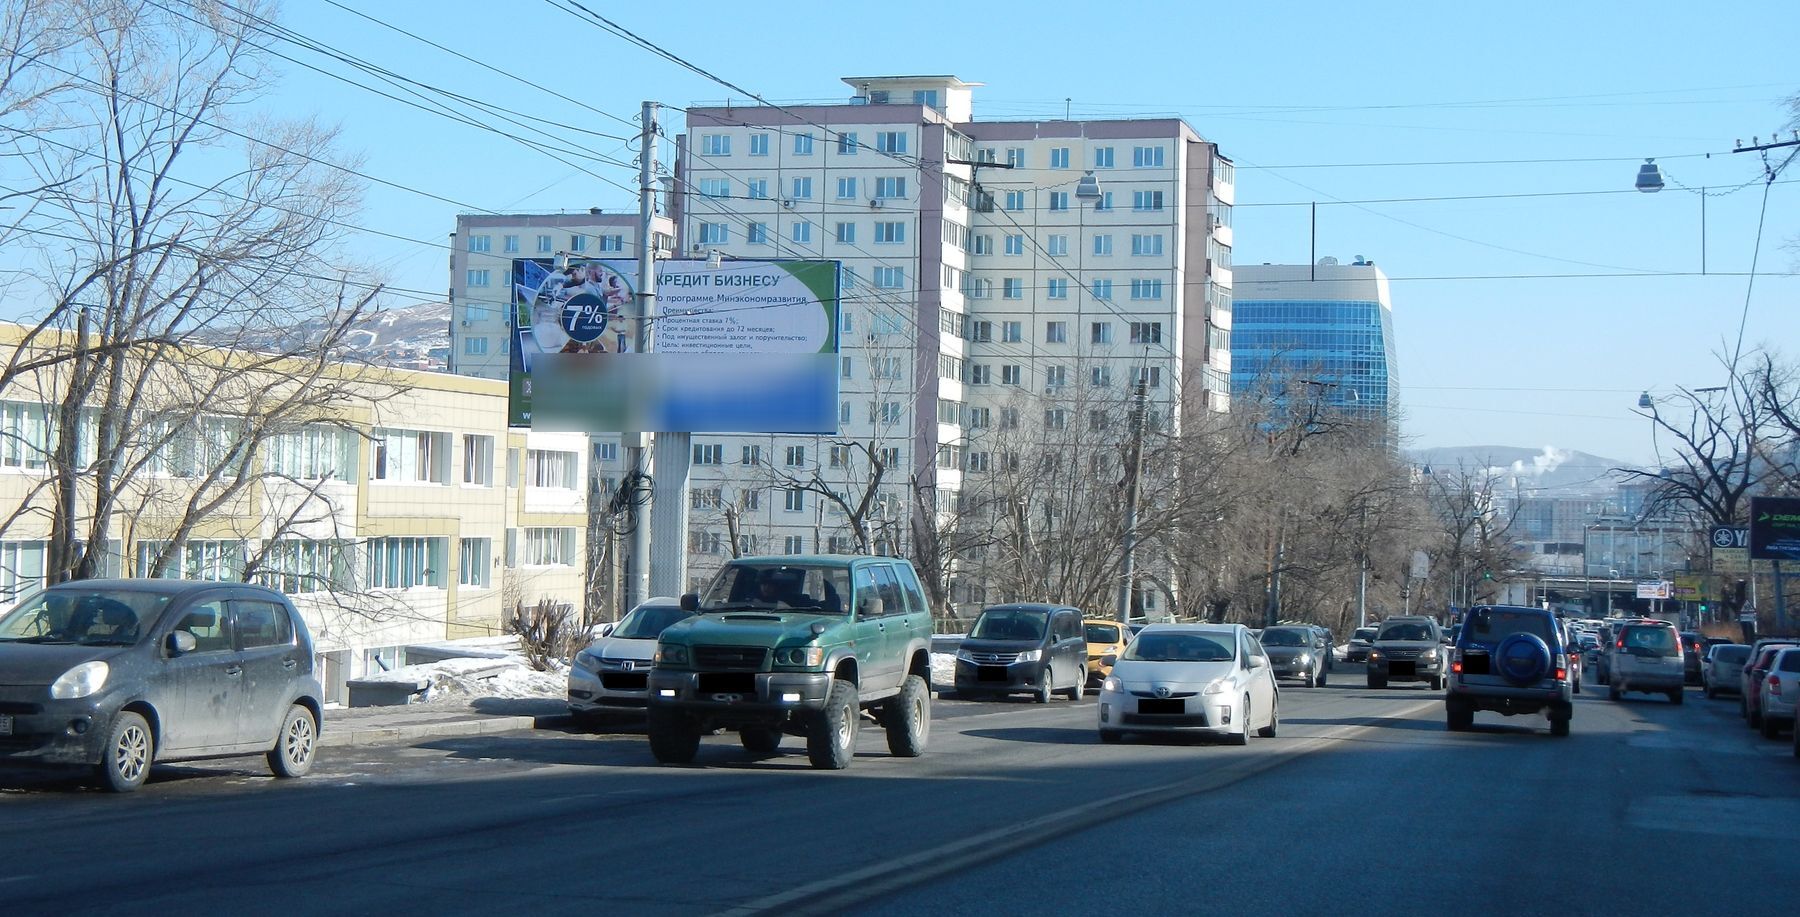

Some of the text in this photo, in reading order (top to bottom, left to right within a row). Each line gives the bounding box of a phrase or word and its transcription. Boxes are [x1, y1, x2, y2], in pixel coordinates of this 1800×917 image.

[656, 274, 779, 288] КРЕДИТ БИЗНЕСУ
[666, 295, 713, 303] программе
[566, 305, 602, 331] 7%
[662, 317, 700, 325] Процентная
